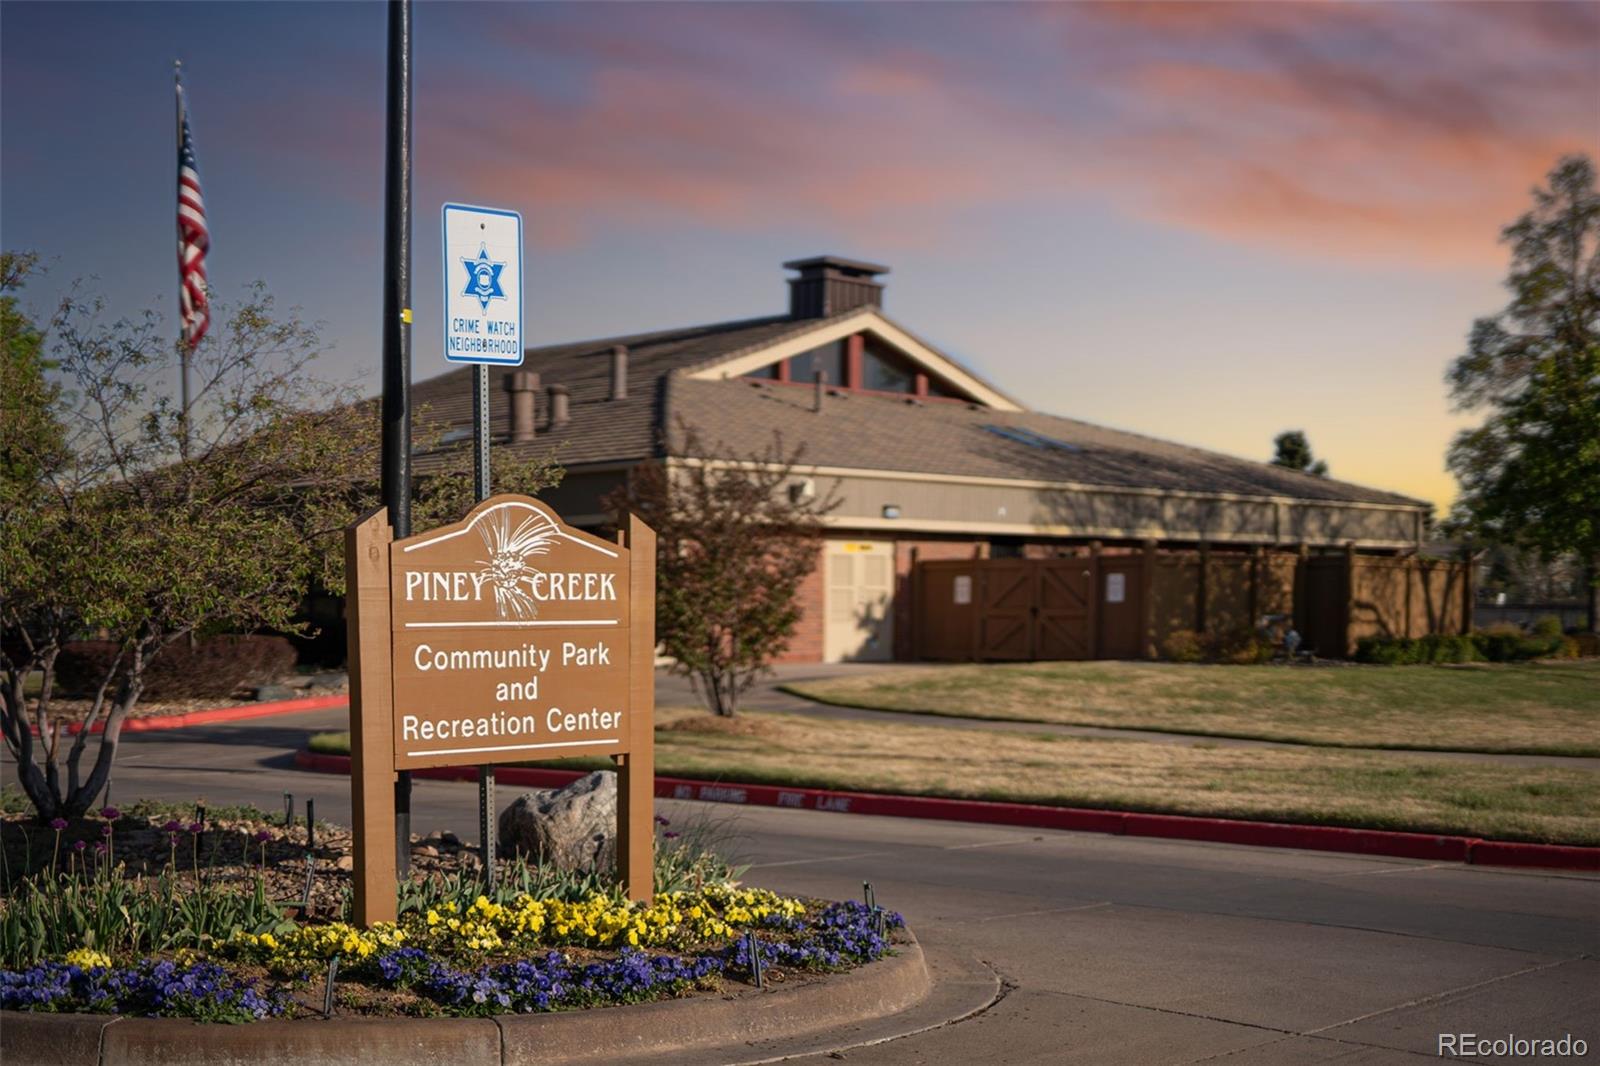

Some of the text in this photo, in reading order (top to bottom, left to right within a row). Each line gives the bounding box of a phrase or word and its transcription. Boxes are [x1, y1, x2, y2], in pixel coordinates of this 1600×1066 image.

[453, 318, 515, 337] CRIME WATCH
[450, 336, 518, 354] NEIGHBORHOOD
[405, 571, 617, 601] PINEY CREEK
[414, 641, 610, 672] Community Park
[495, 675, 538, 701] and
[403, 707, 622, 740] Recreation Center
[815, 796, 852, 812] LANE
